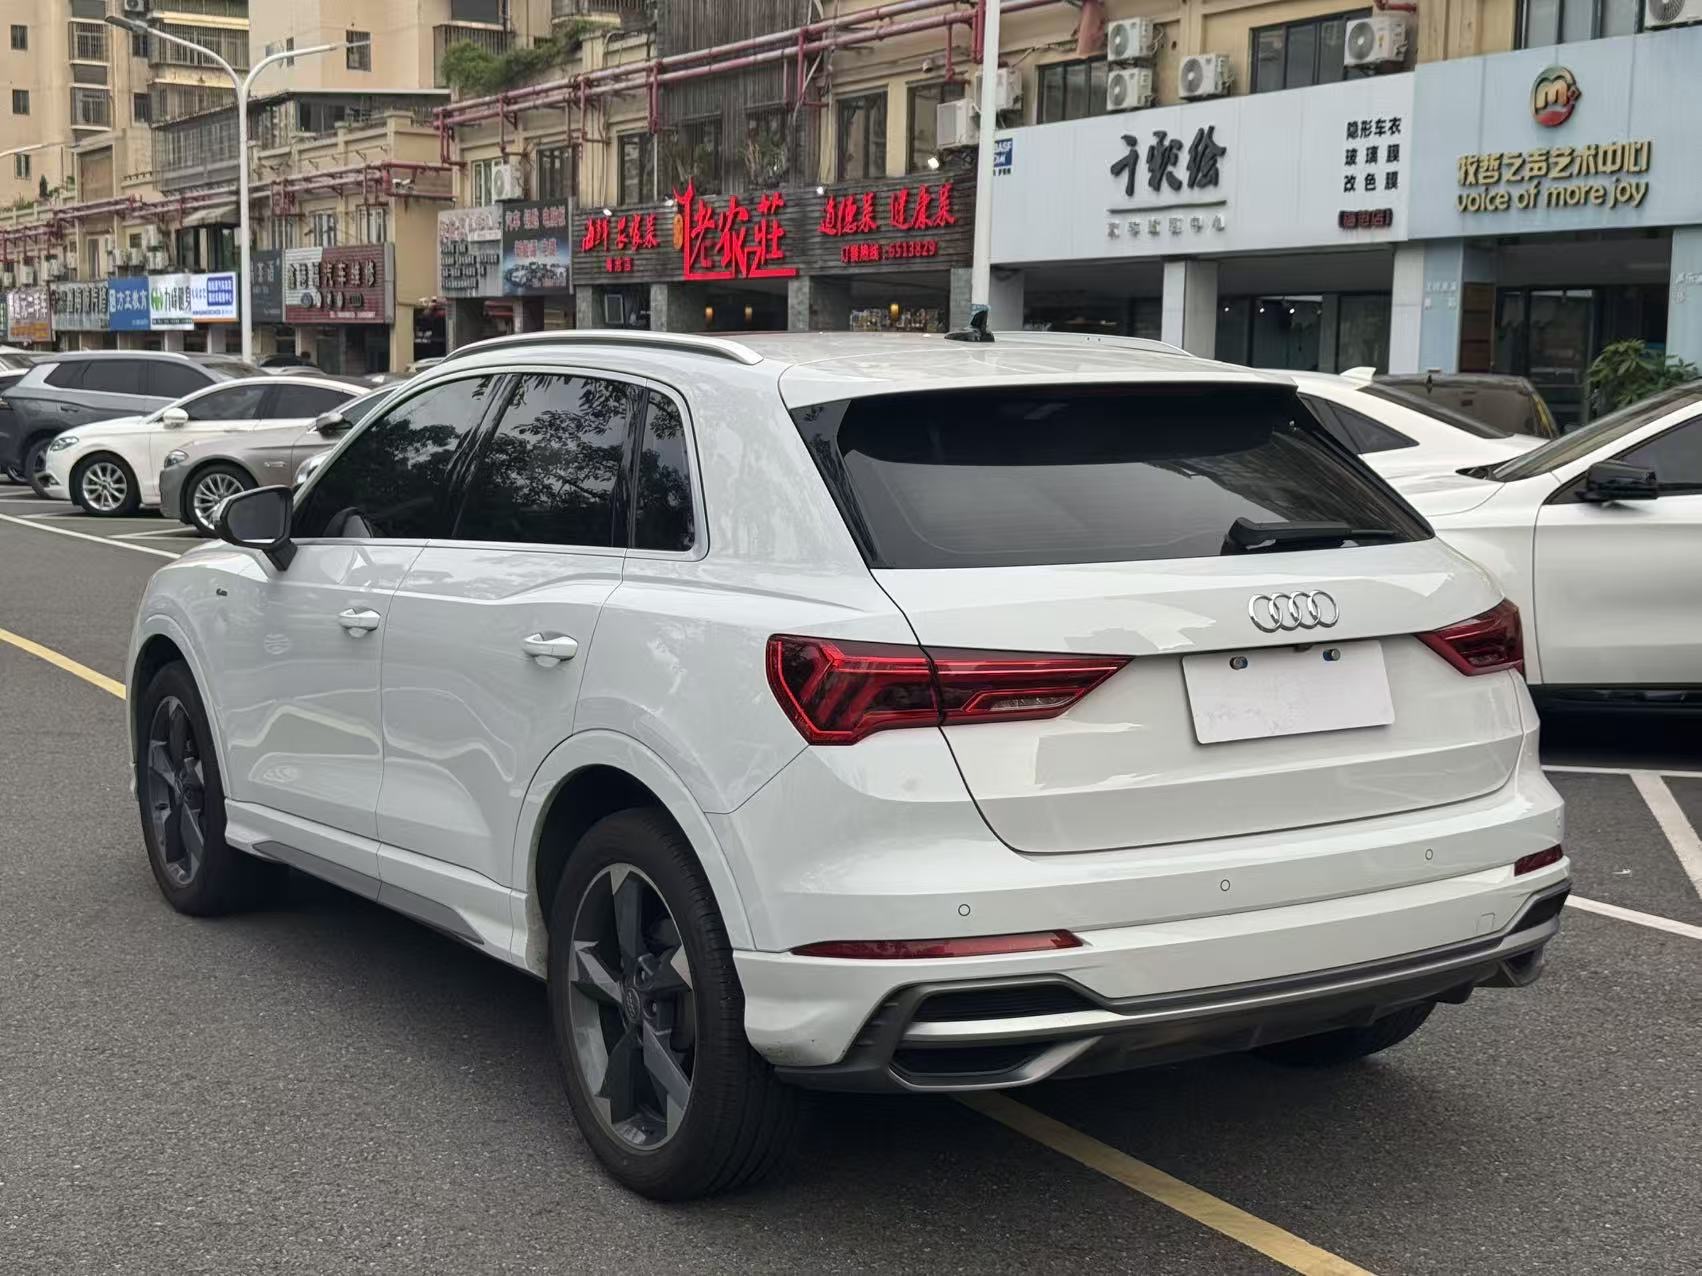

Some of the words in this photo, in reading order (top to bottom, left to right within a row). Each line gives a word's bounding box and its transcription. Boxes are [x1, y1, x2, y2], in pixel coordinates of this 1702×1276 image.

[1346, 117, 1402, 140] 隐形车衣
[1345, 144, 1400, 167] 玻璃膜
[1343, 171, 1399, 194] 改色膜
[1456, 187, 1510, 213] voice
[1515, 181, 1541, 208] of
[1545, 183, 1606, 209] more
[1608, 177, 1649, 209] joy
